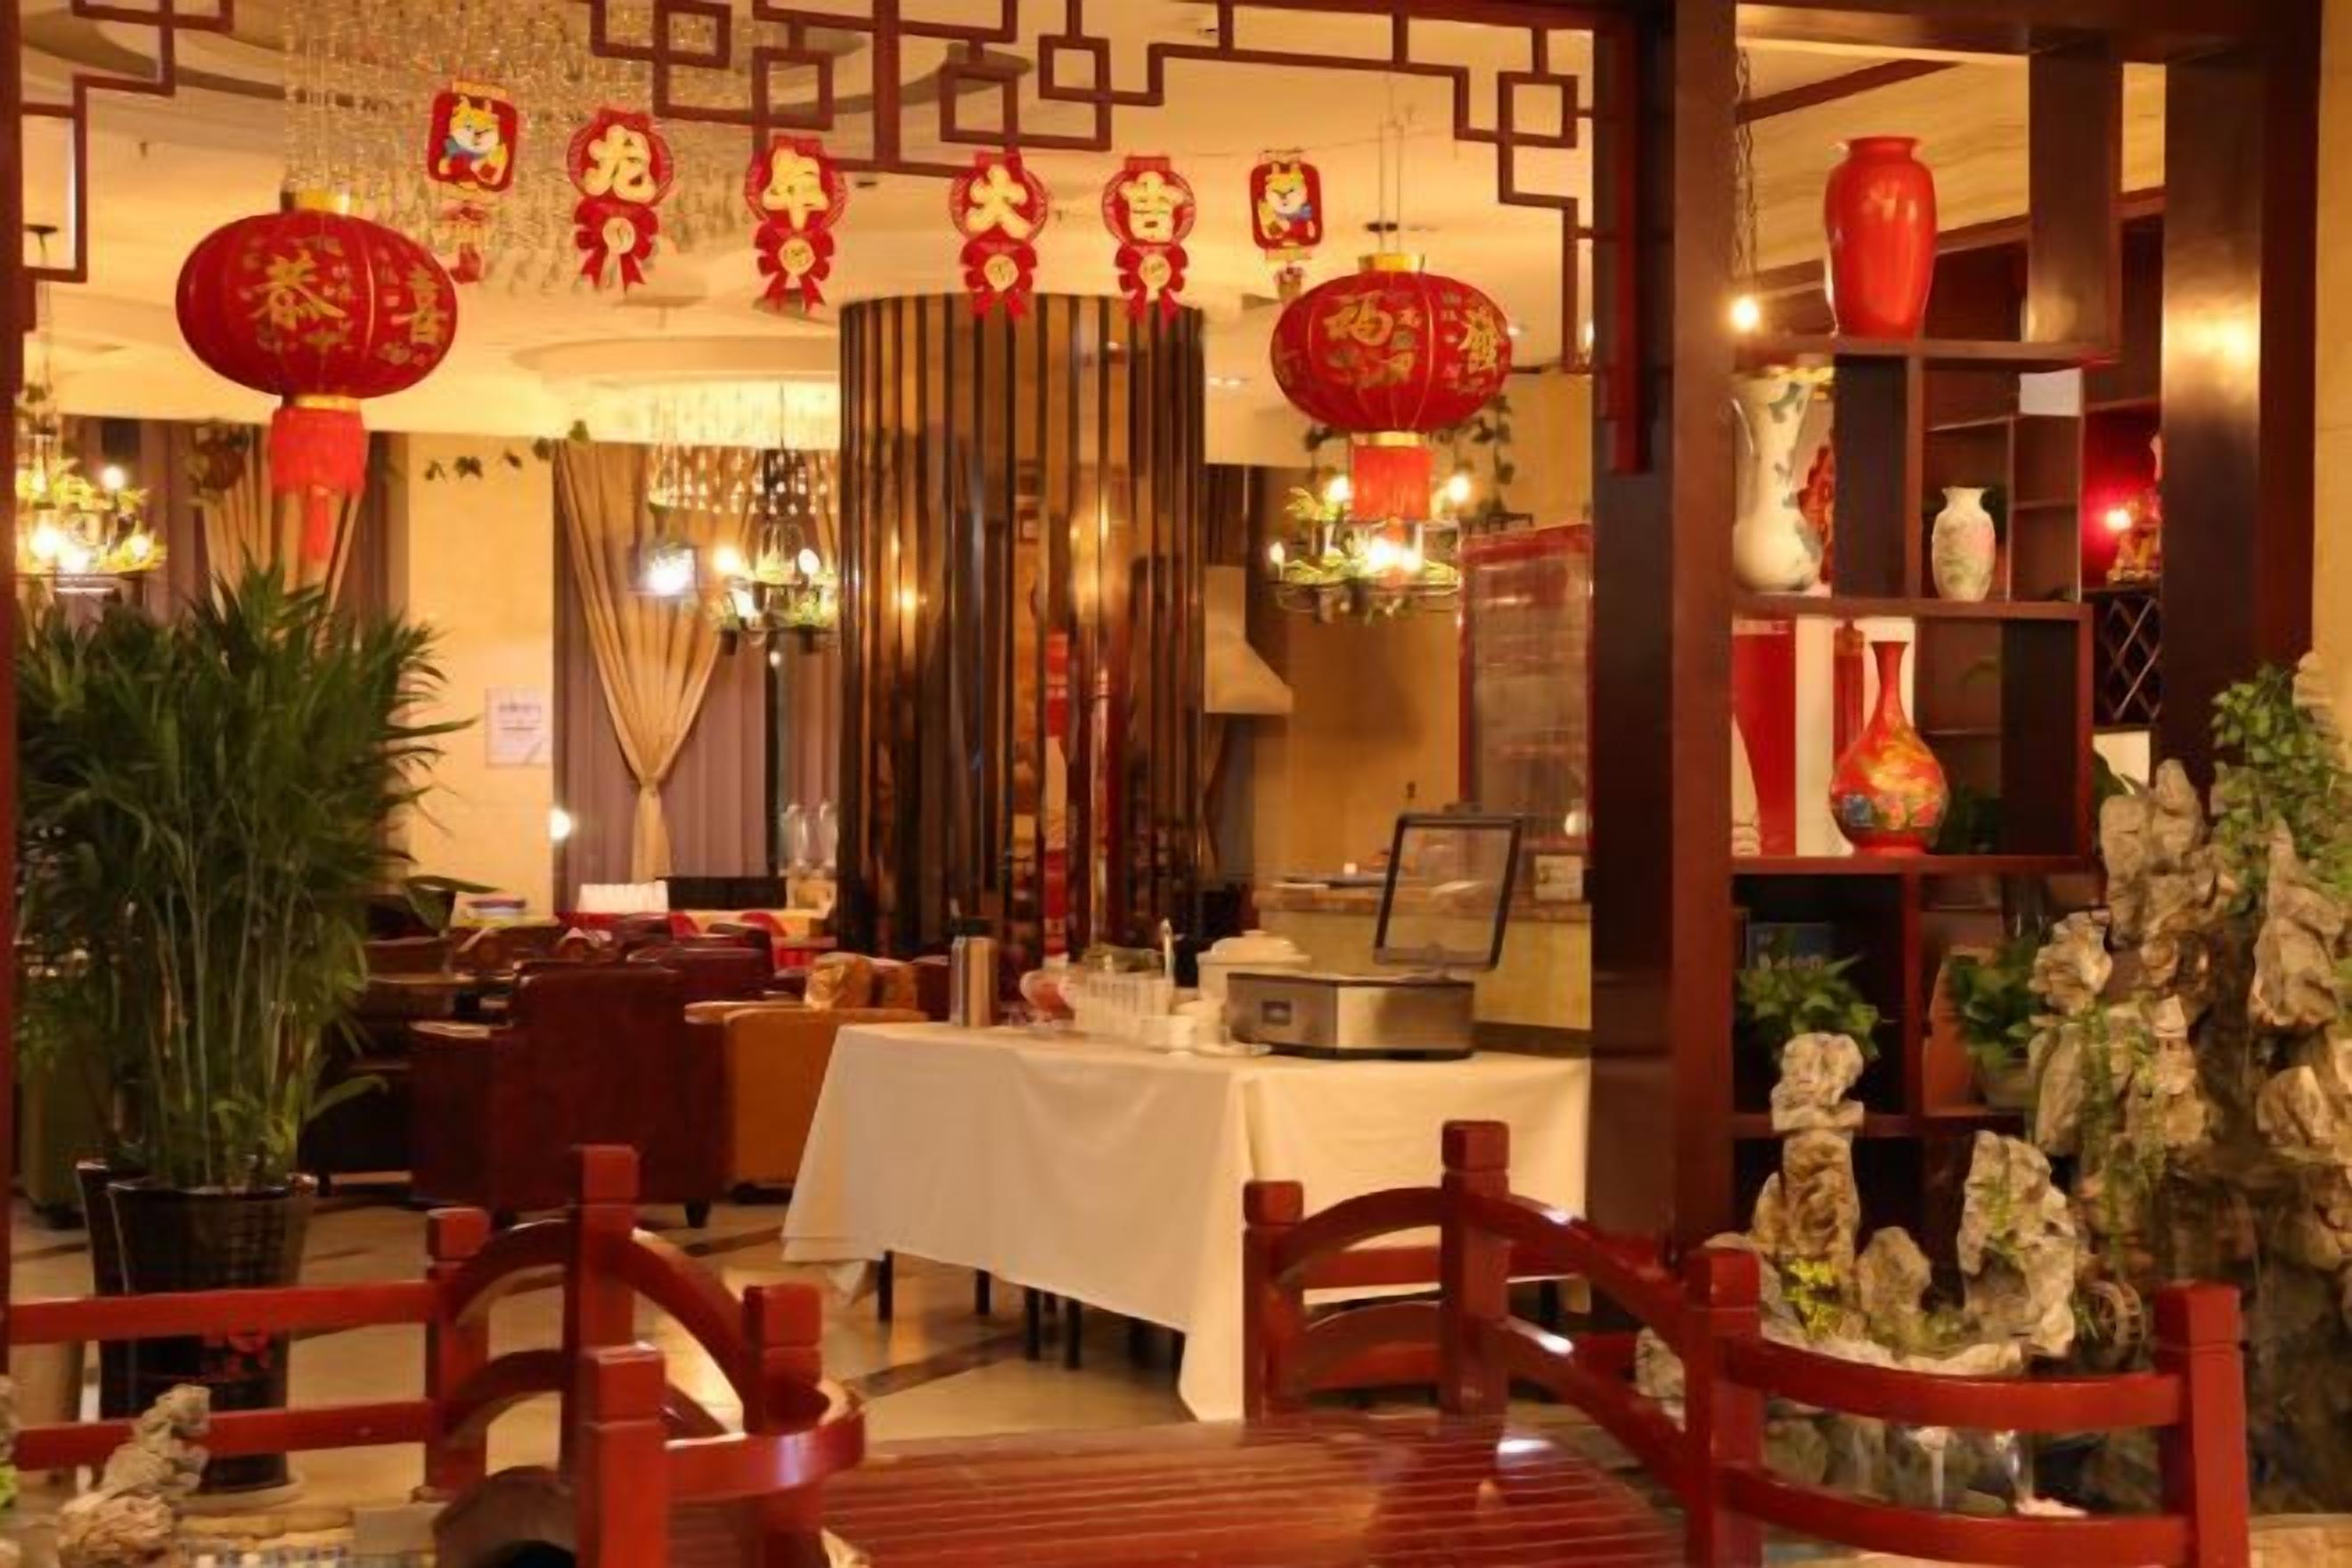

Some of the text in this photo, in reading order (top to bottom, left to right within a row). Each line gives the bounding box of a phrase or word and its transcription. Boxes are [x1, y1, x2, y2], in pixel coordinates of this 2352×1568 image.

[763, 146, 829, 230] 年
[966, 165, 1030, 239] 大
[1117, 171, 1186, 243] 吉
